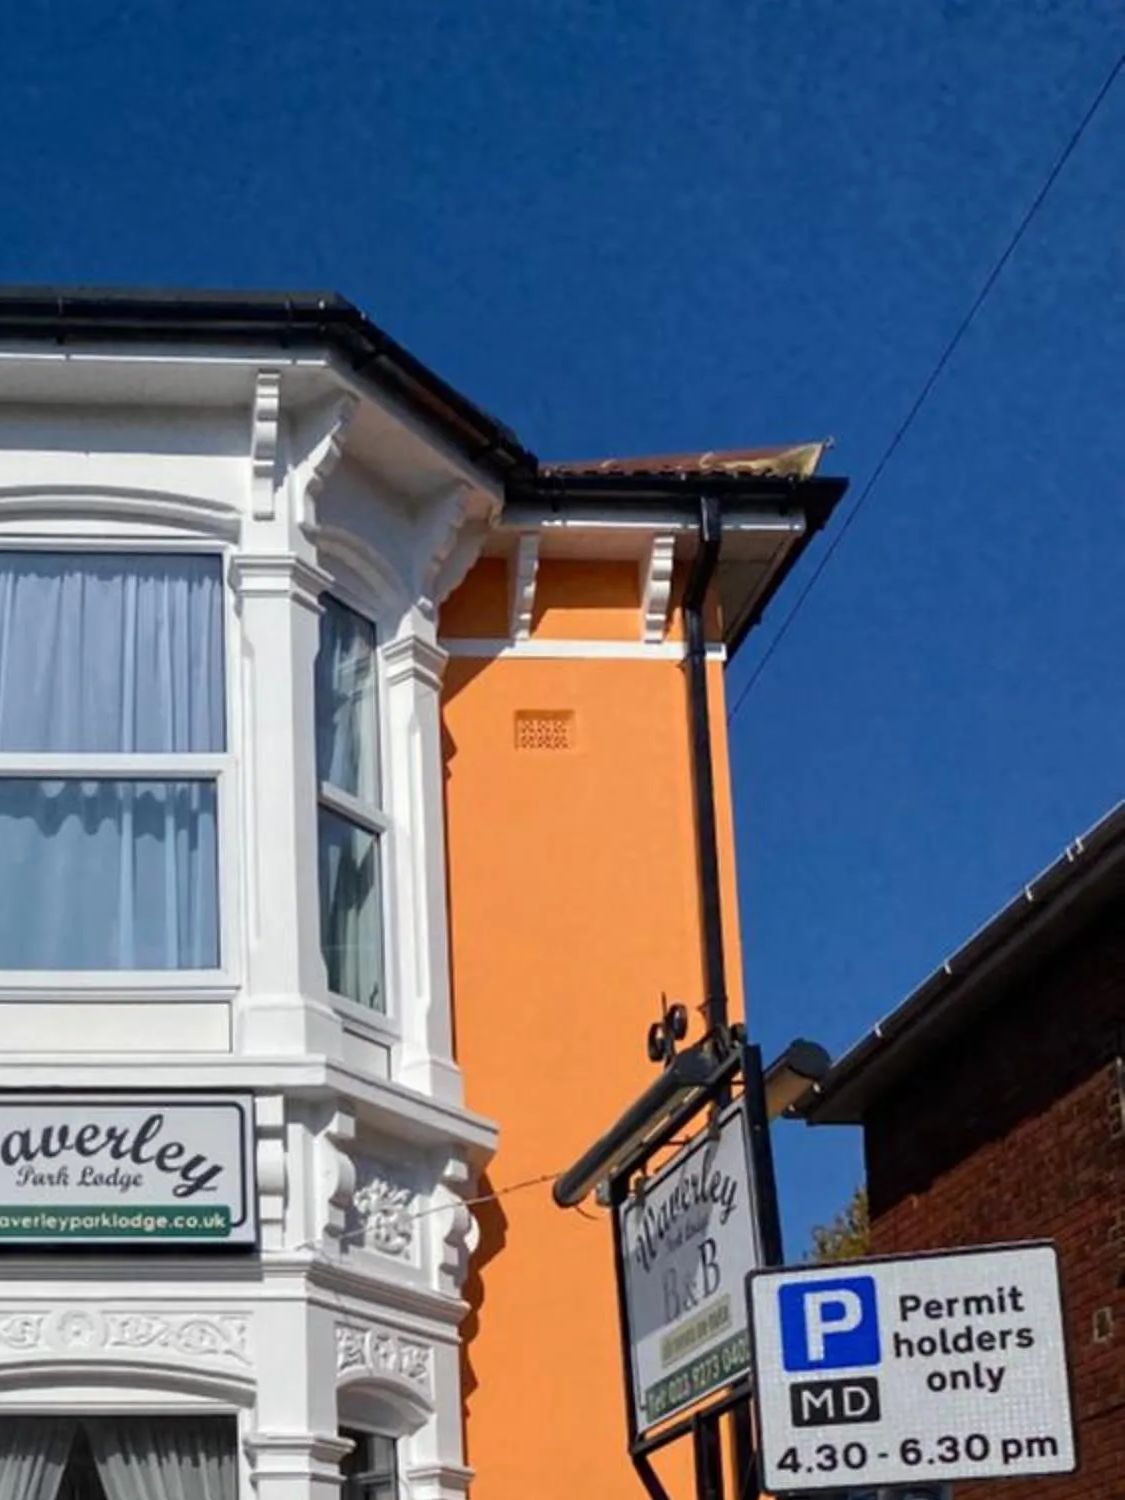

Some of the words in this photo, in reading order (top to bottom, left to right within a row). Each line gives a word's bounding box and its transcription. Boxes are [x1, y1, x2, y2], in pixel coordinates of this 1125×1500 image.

[16, 1166, 69, 1188] Park
[77, 1165, 144, 1192] Lodge
[636, 1147, 737, 1273] Waverley
[899, 1286, 1025, 1322] Permit
[803, 1288, 863, 1362] P
[893, 1326, 1035, 1358] holders
[926, 1361, 1006, 1393] only
[801, 1385, 871, 1421] MD
[777, 1443, 867, 1473] 4.30
[899, 1434, 990, 1466] 6.30
[1001, 1434, 1059, 1464] pm
